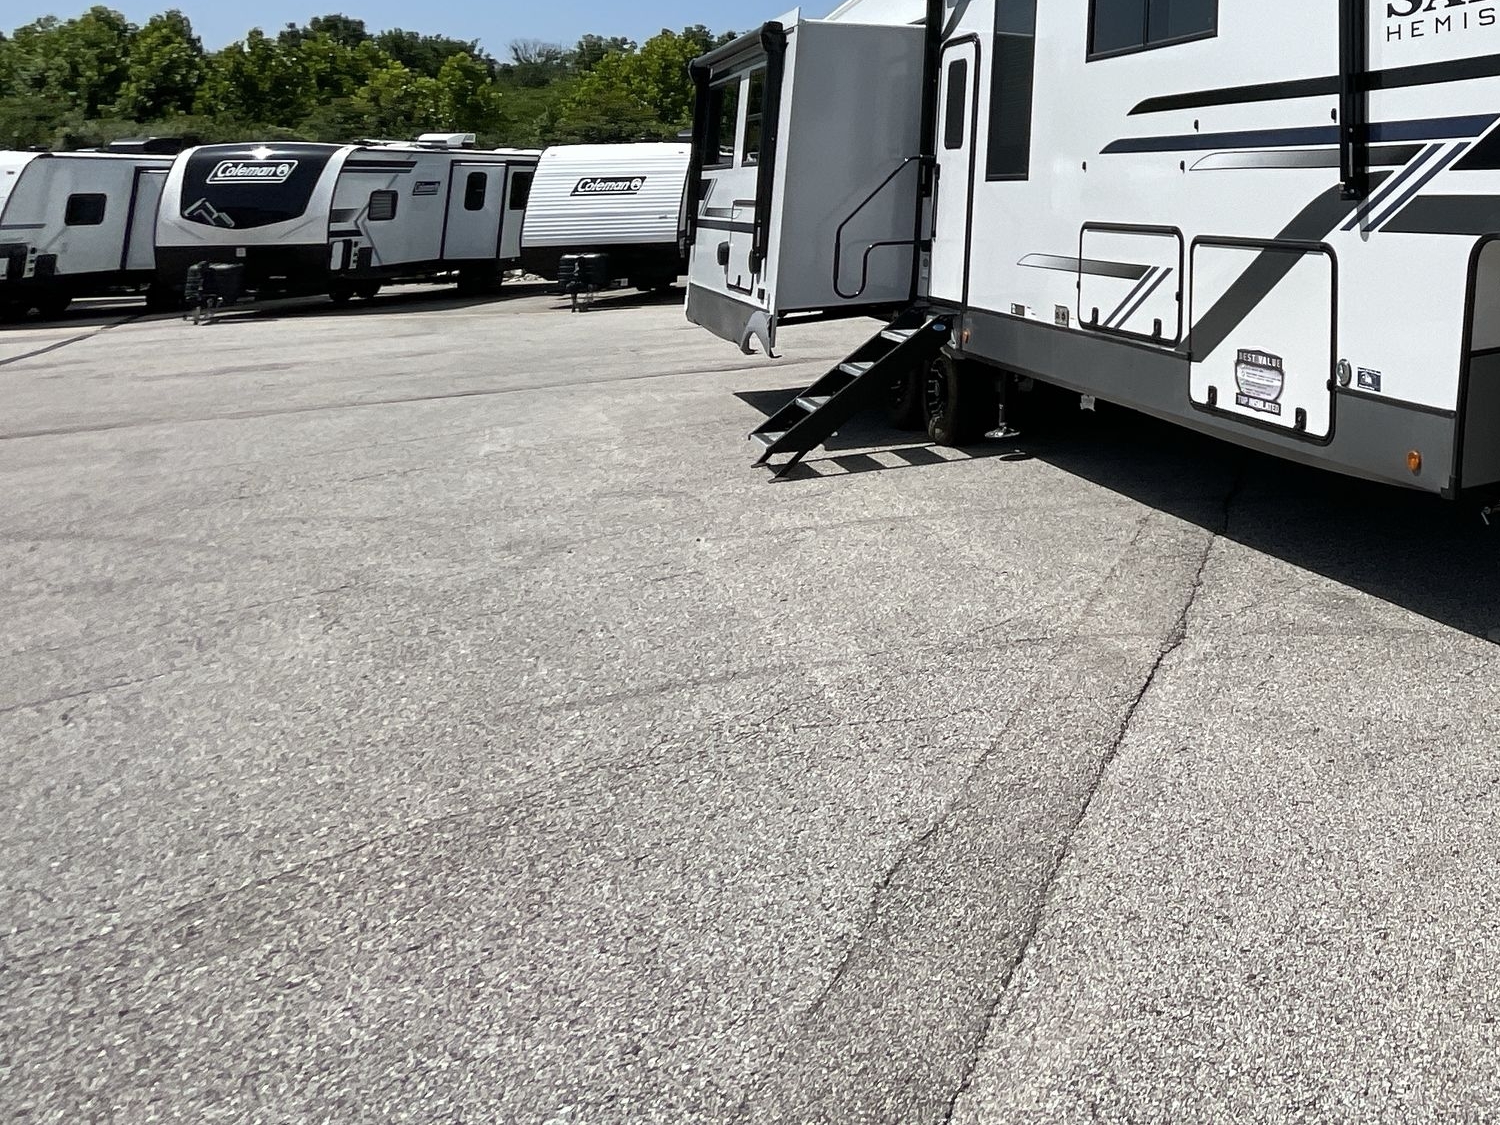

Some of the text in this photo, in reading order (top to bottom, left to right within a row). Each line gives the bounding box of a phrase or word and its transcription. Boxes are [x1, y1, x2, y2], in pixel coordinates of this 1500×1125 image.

[218, 163, 276, 177] Coleman
[577, 178, 630, 192] Coleman
[1258, 355, 1281, 368] VALUE
